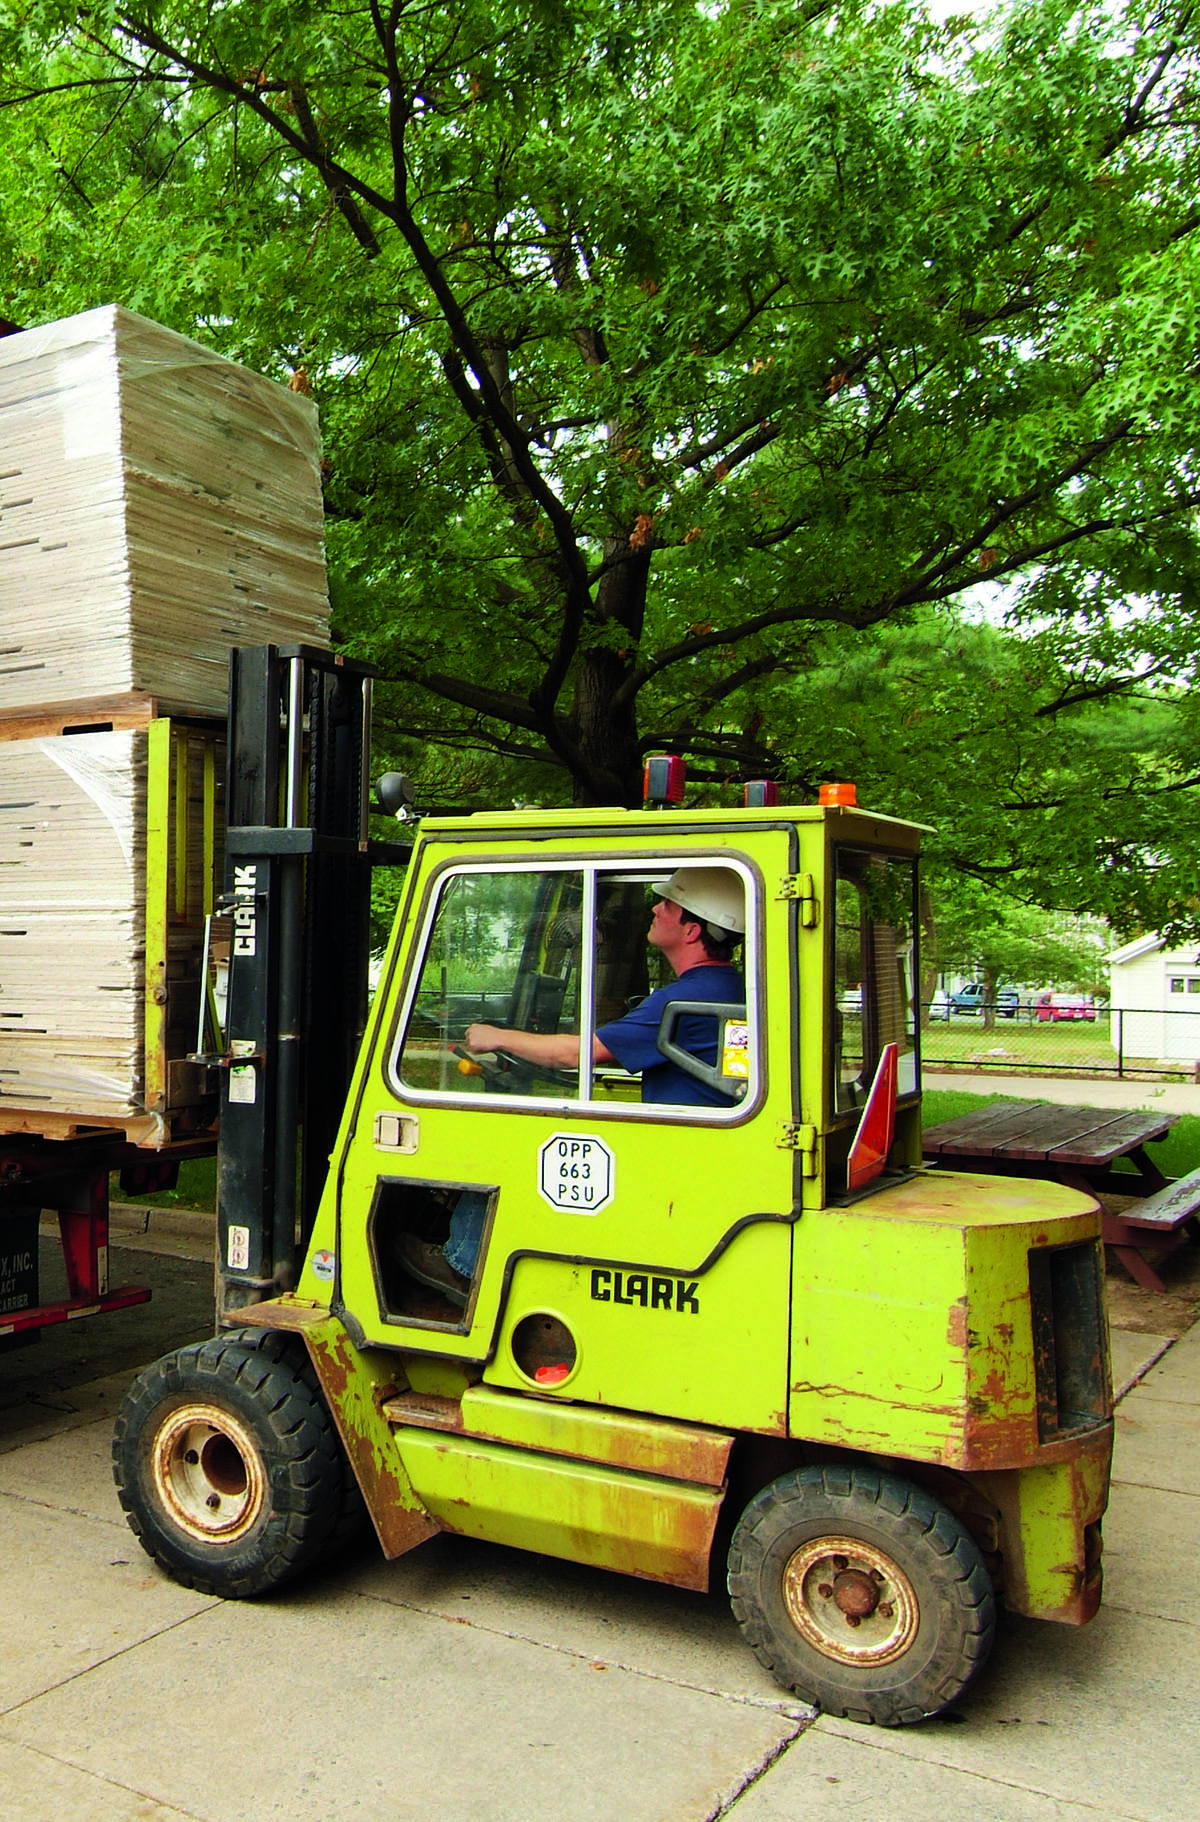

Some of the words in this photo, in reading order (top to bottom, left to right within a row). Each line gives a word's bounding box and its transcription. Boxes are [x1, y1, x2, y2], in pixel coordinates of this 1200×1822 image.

[234, 865, 257, 956] CLARK
[558, 1142, 592, 1158] OPP
[559, 1163, 591, 1179] 663
[558, 1184, 594, 1202] PSU
[12, 1252, 33, 1273] INC.
[591, 1268, 699, 1314] CLARK
